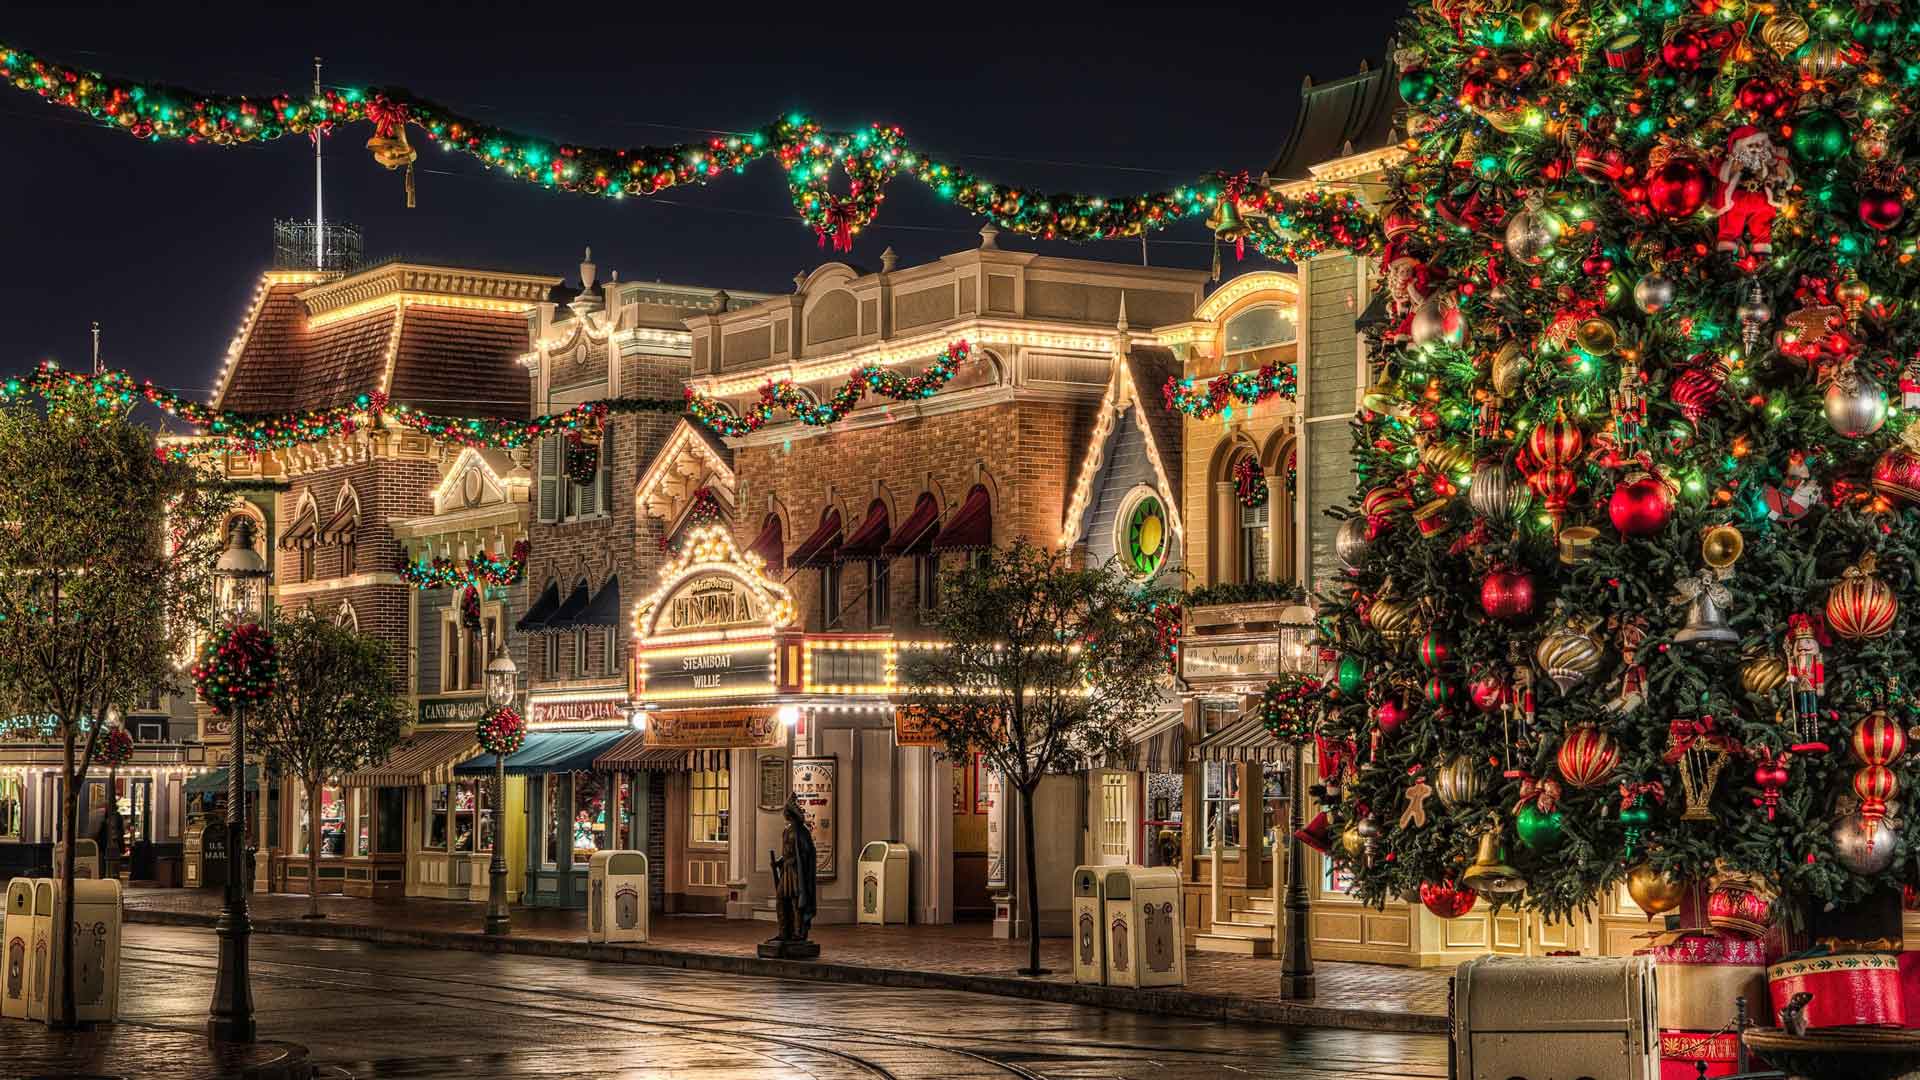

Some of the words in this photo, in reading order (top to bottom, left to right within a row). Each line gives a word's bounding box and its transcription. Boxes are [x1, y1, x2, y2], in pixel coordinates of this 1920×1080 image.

[672, 592, 751, 629] CINEMA
[683, 655, 731, 670] STEAMBOAT
[693, 674, 721, 689] WILLIE
[425, 703, 456, 719] CANNED
[793, 783, 832, 793] INEMA
[205, 851, 225, 860] MAIL
